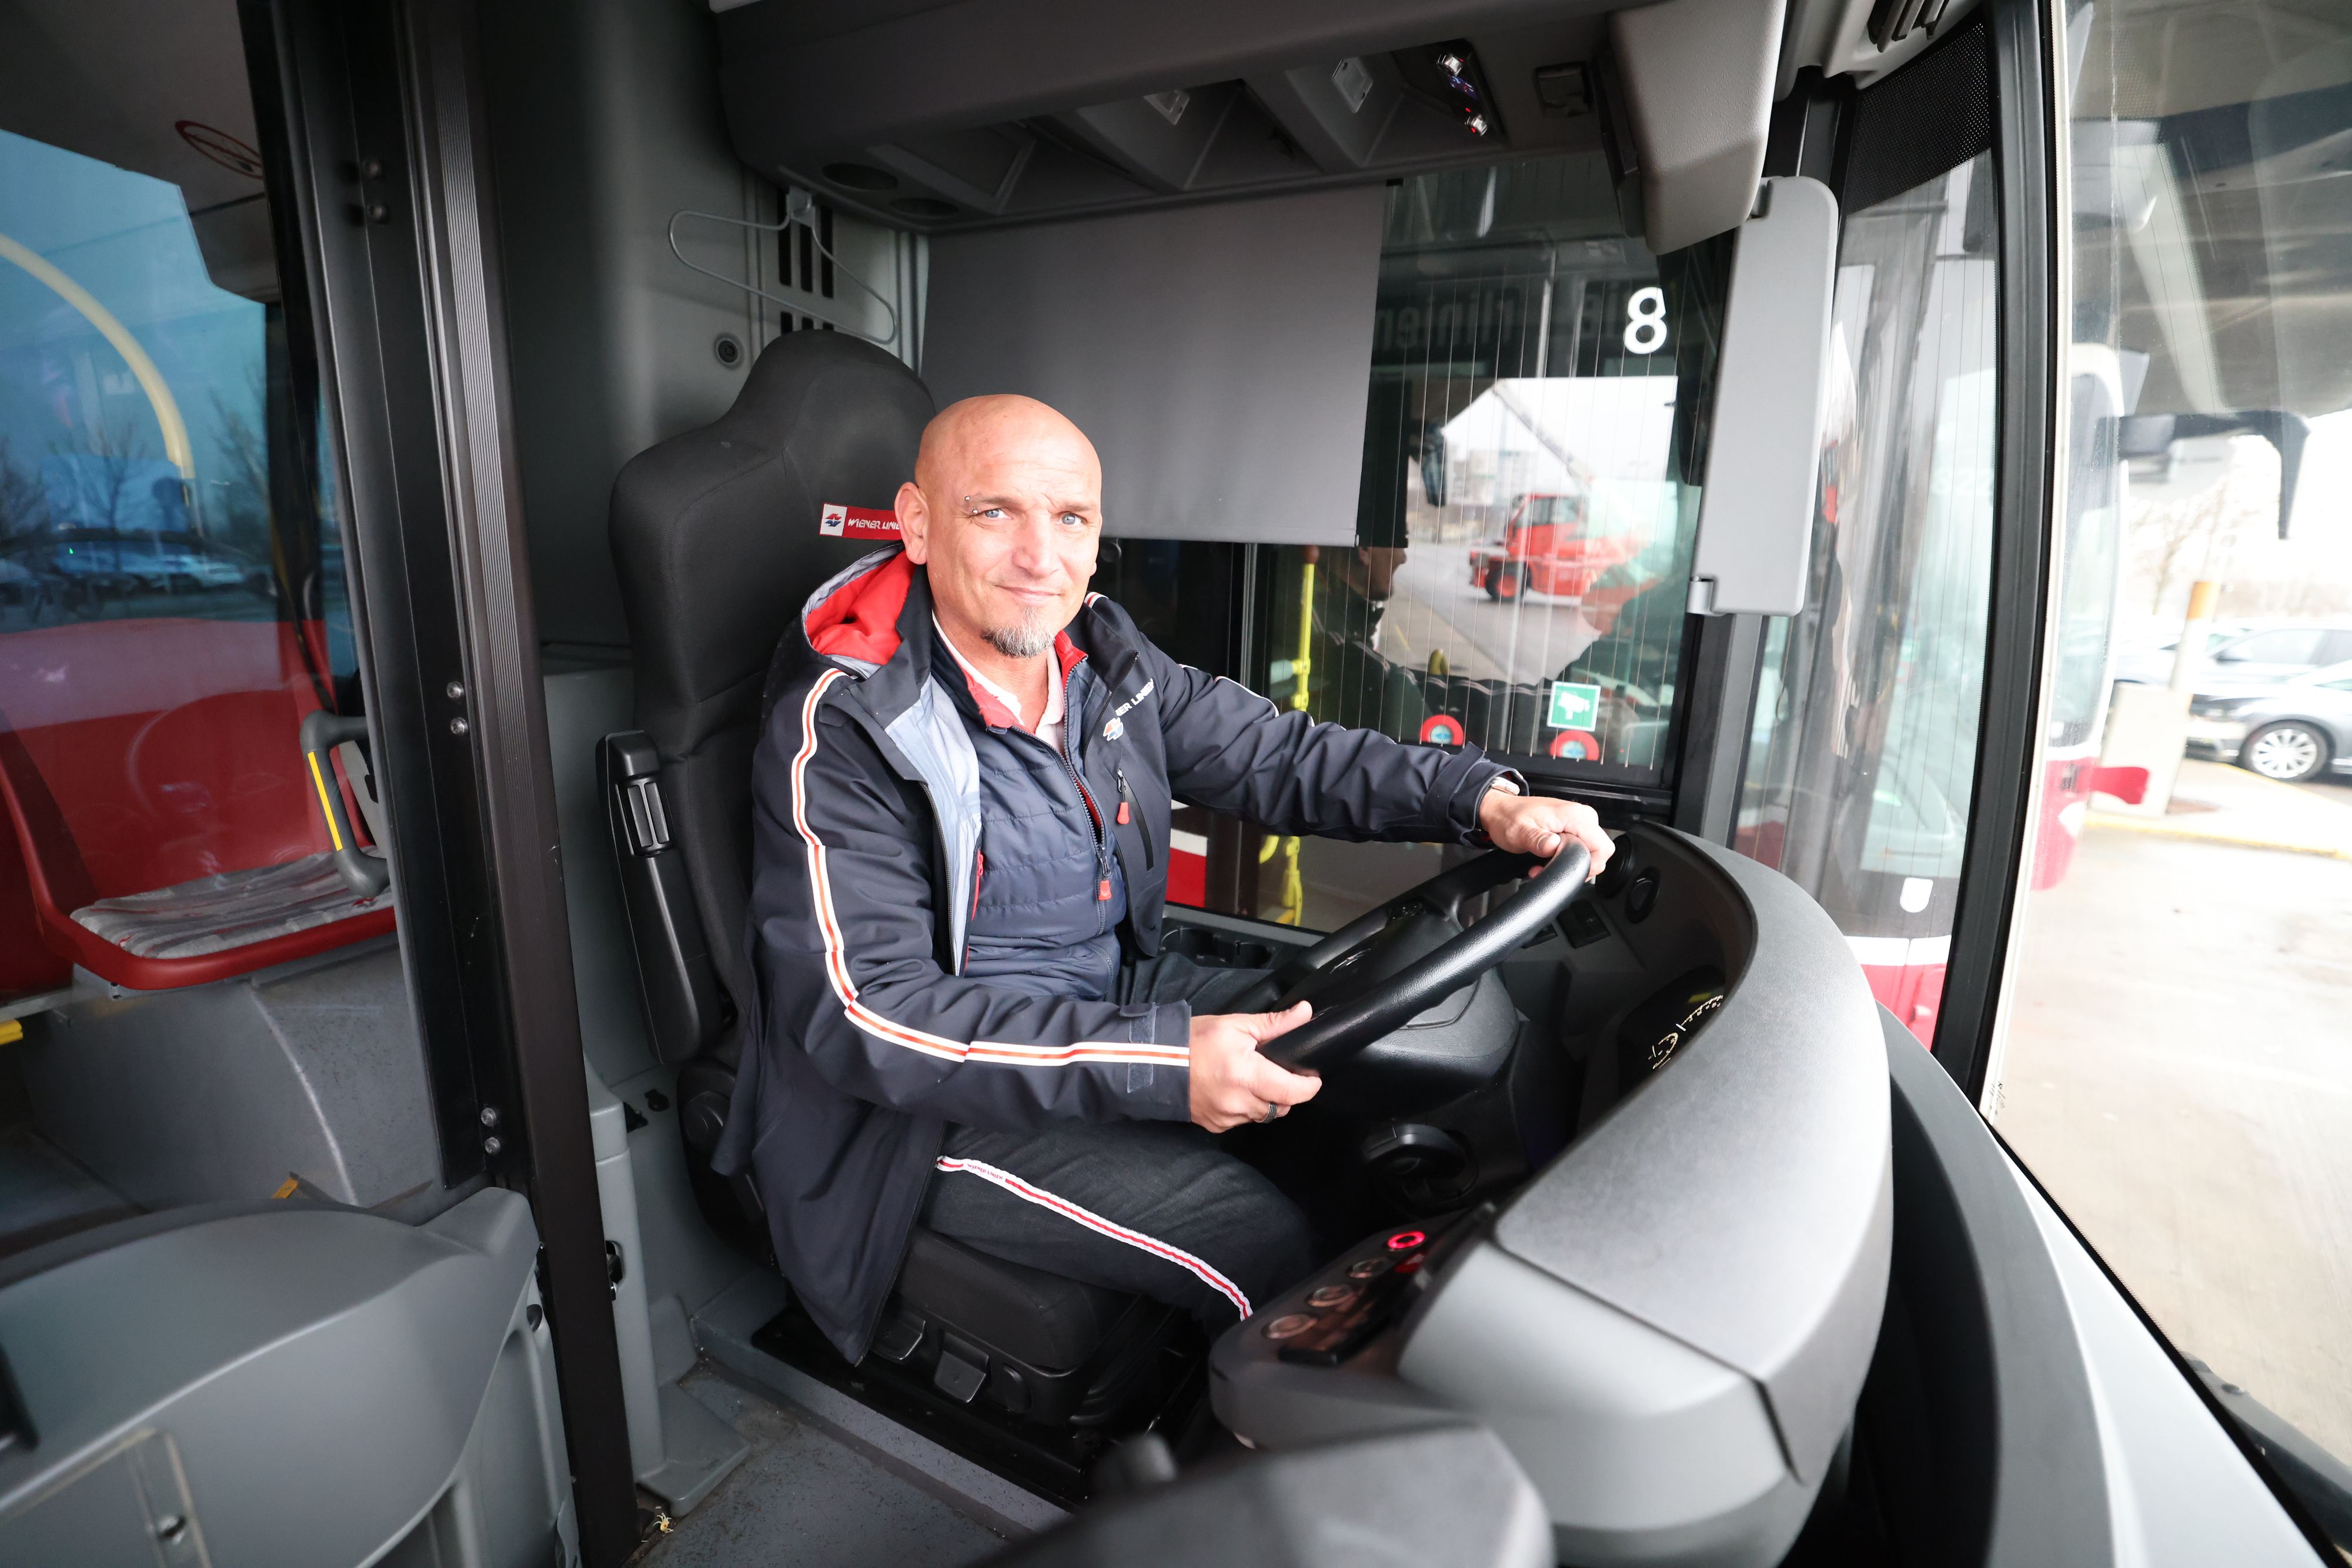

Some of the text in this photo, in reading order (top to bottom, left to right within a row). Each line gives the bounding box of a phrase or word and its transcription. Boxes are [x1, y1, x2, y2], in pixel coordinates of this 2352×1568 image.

[1624, 286, 1667, 355] 8
[848, 519, 900, 530] WIENER LINIE
[967, 1164, 1003, 1179] WIENER LINIEN
